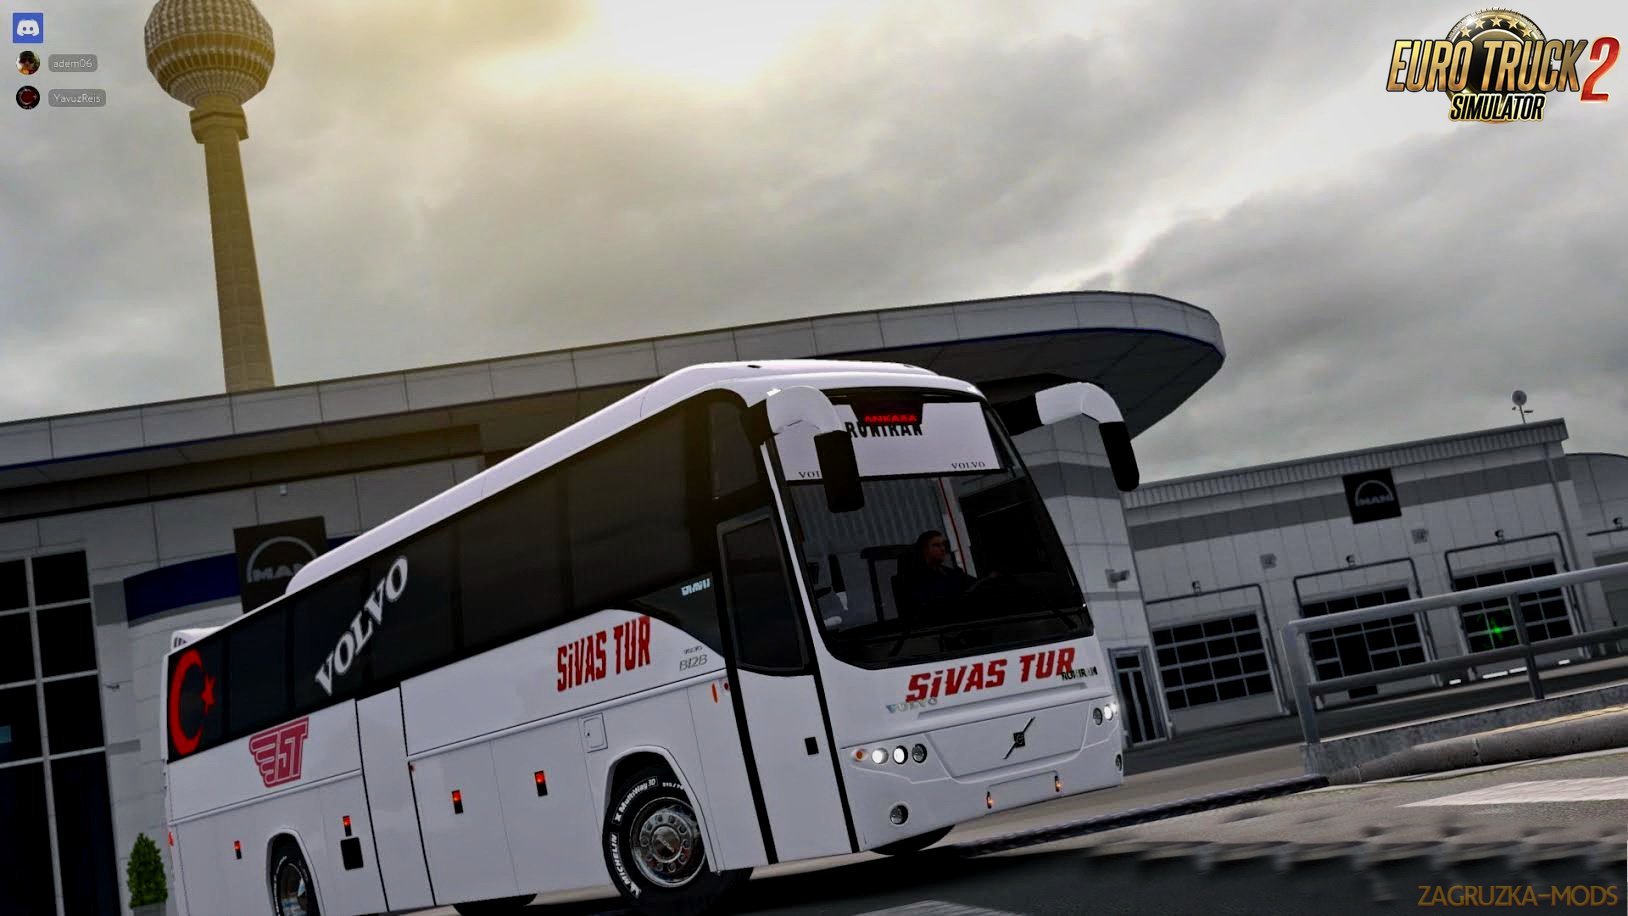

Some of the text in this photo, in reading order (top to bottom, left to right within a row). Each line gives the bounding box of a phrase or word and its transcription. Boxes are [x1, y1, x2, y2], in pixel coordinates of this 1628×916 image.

[798, 470, 821, 479] VOL
[951, 461, 987, 470] VOLVO
[314, 555, 409, 696] VOLVO
[613, 614, 651, 676] TUR
[1019, 647, 1076, 683] TUR
